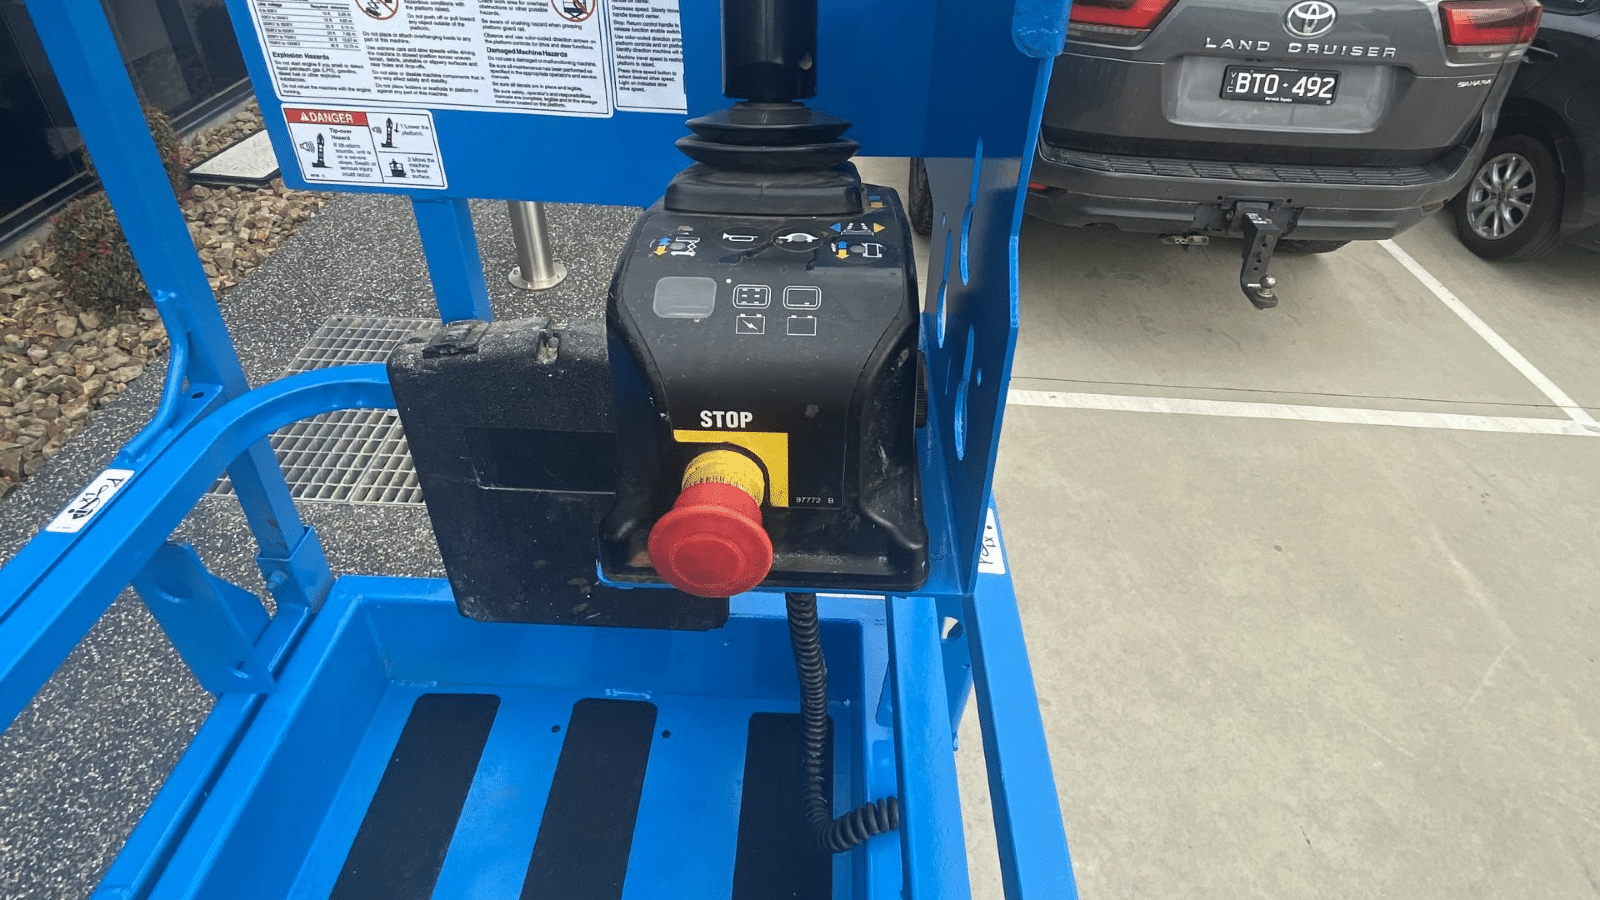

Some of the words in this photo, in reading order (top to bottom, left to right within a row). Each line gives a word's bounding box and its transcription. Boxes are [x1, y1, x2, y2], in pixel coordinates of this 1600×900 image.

[487, 46, 516, 56] Damaged
[1206, 38, 1270, 51] LAND
[1288, 43, 1396, 57] CRUISER
[272, 51, 303, 60] Explosion
[309, 111, 354, 123] DANGER
[700, 410, 753, 428] STOP
